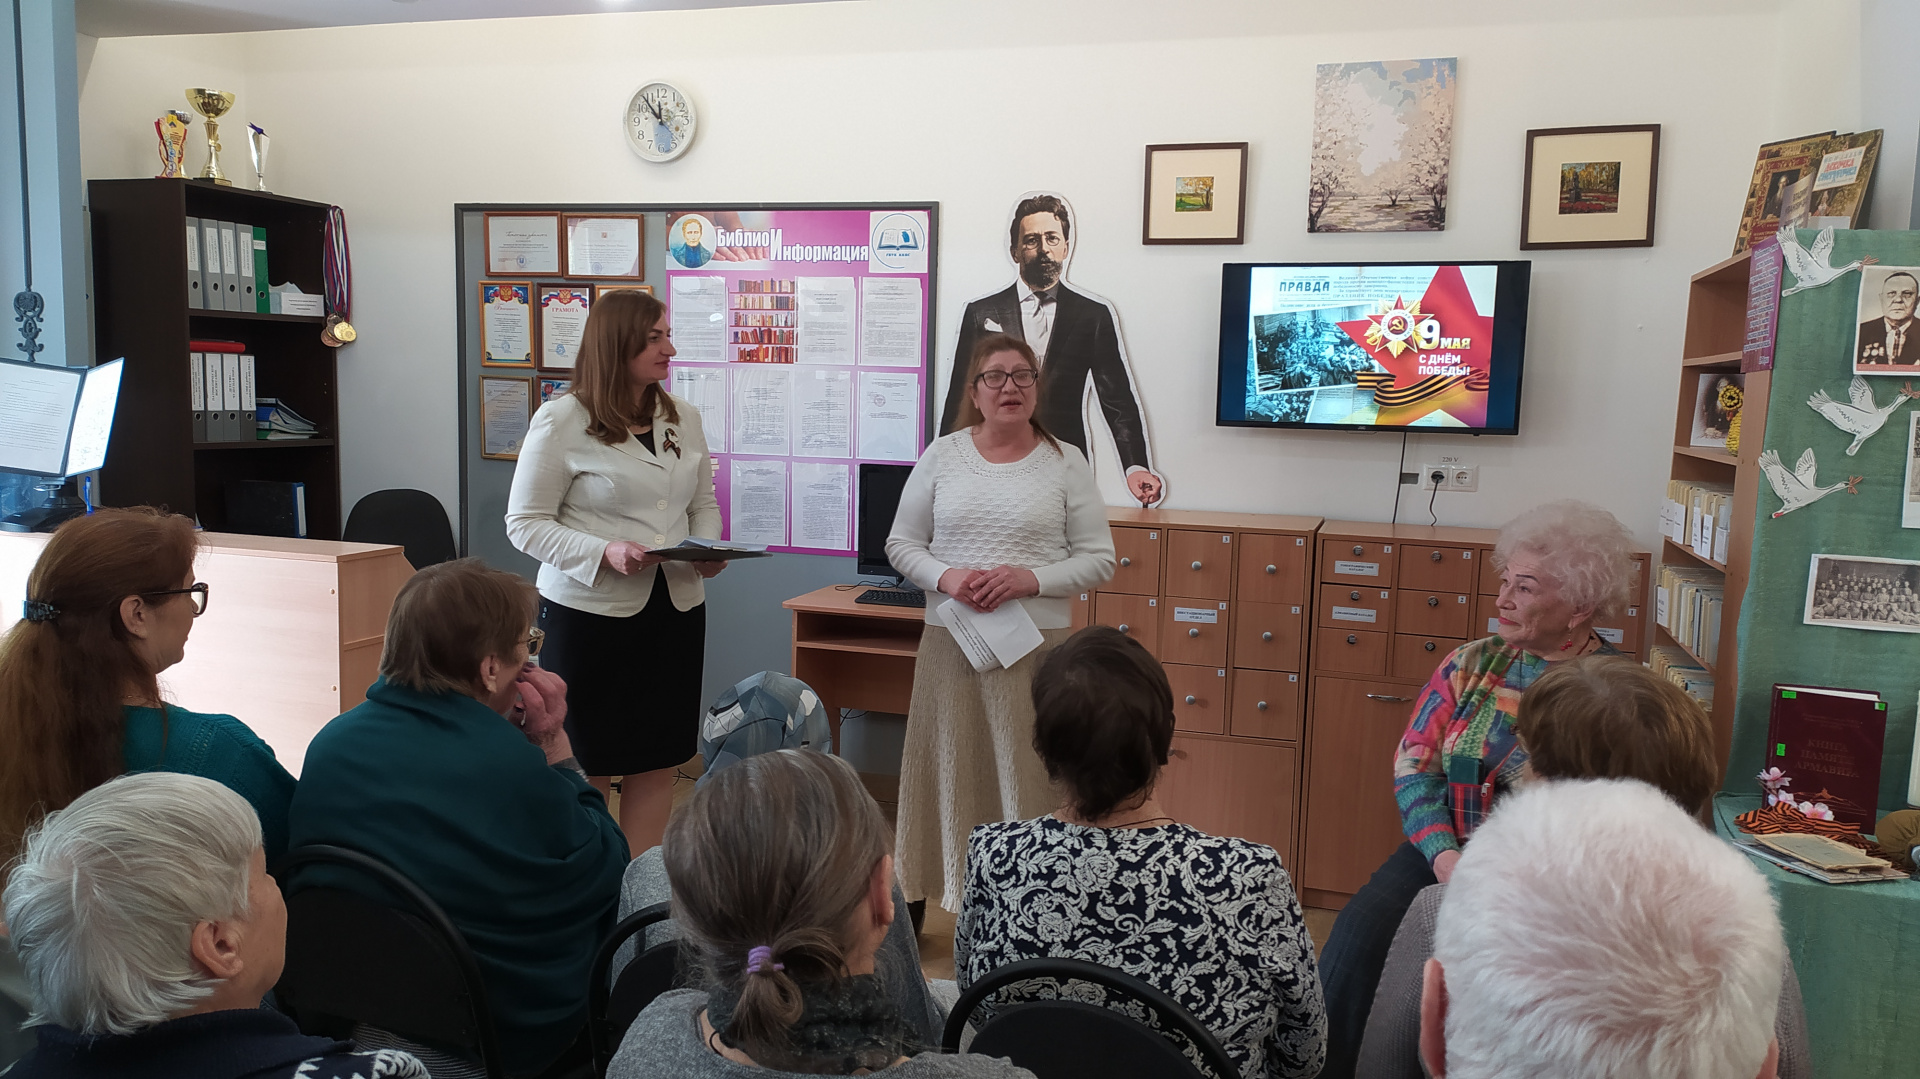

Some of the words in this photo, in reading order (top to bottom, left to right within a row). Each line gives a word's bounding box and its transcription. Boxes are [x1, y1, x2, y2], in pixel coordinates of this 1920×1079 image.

[656, 88, 668, 98] 12
[637, 103, 648, 113] 10
[1279, 281, 1331, 293] ПРАВДА
[1419, 319, 1440, 350] 9
[1440, 337, 1472, 350] МАЯ
[1419, 354, 1427, 363] С
[1428, 352, 1461, 365] ДНЁМ
[1418, 365, 1471, 377] ПОБЕДЫ!
[1806, 738, 1849, 753] КНИГА
[1794, 760, 1860, 778] АРМАВИРА
